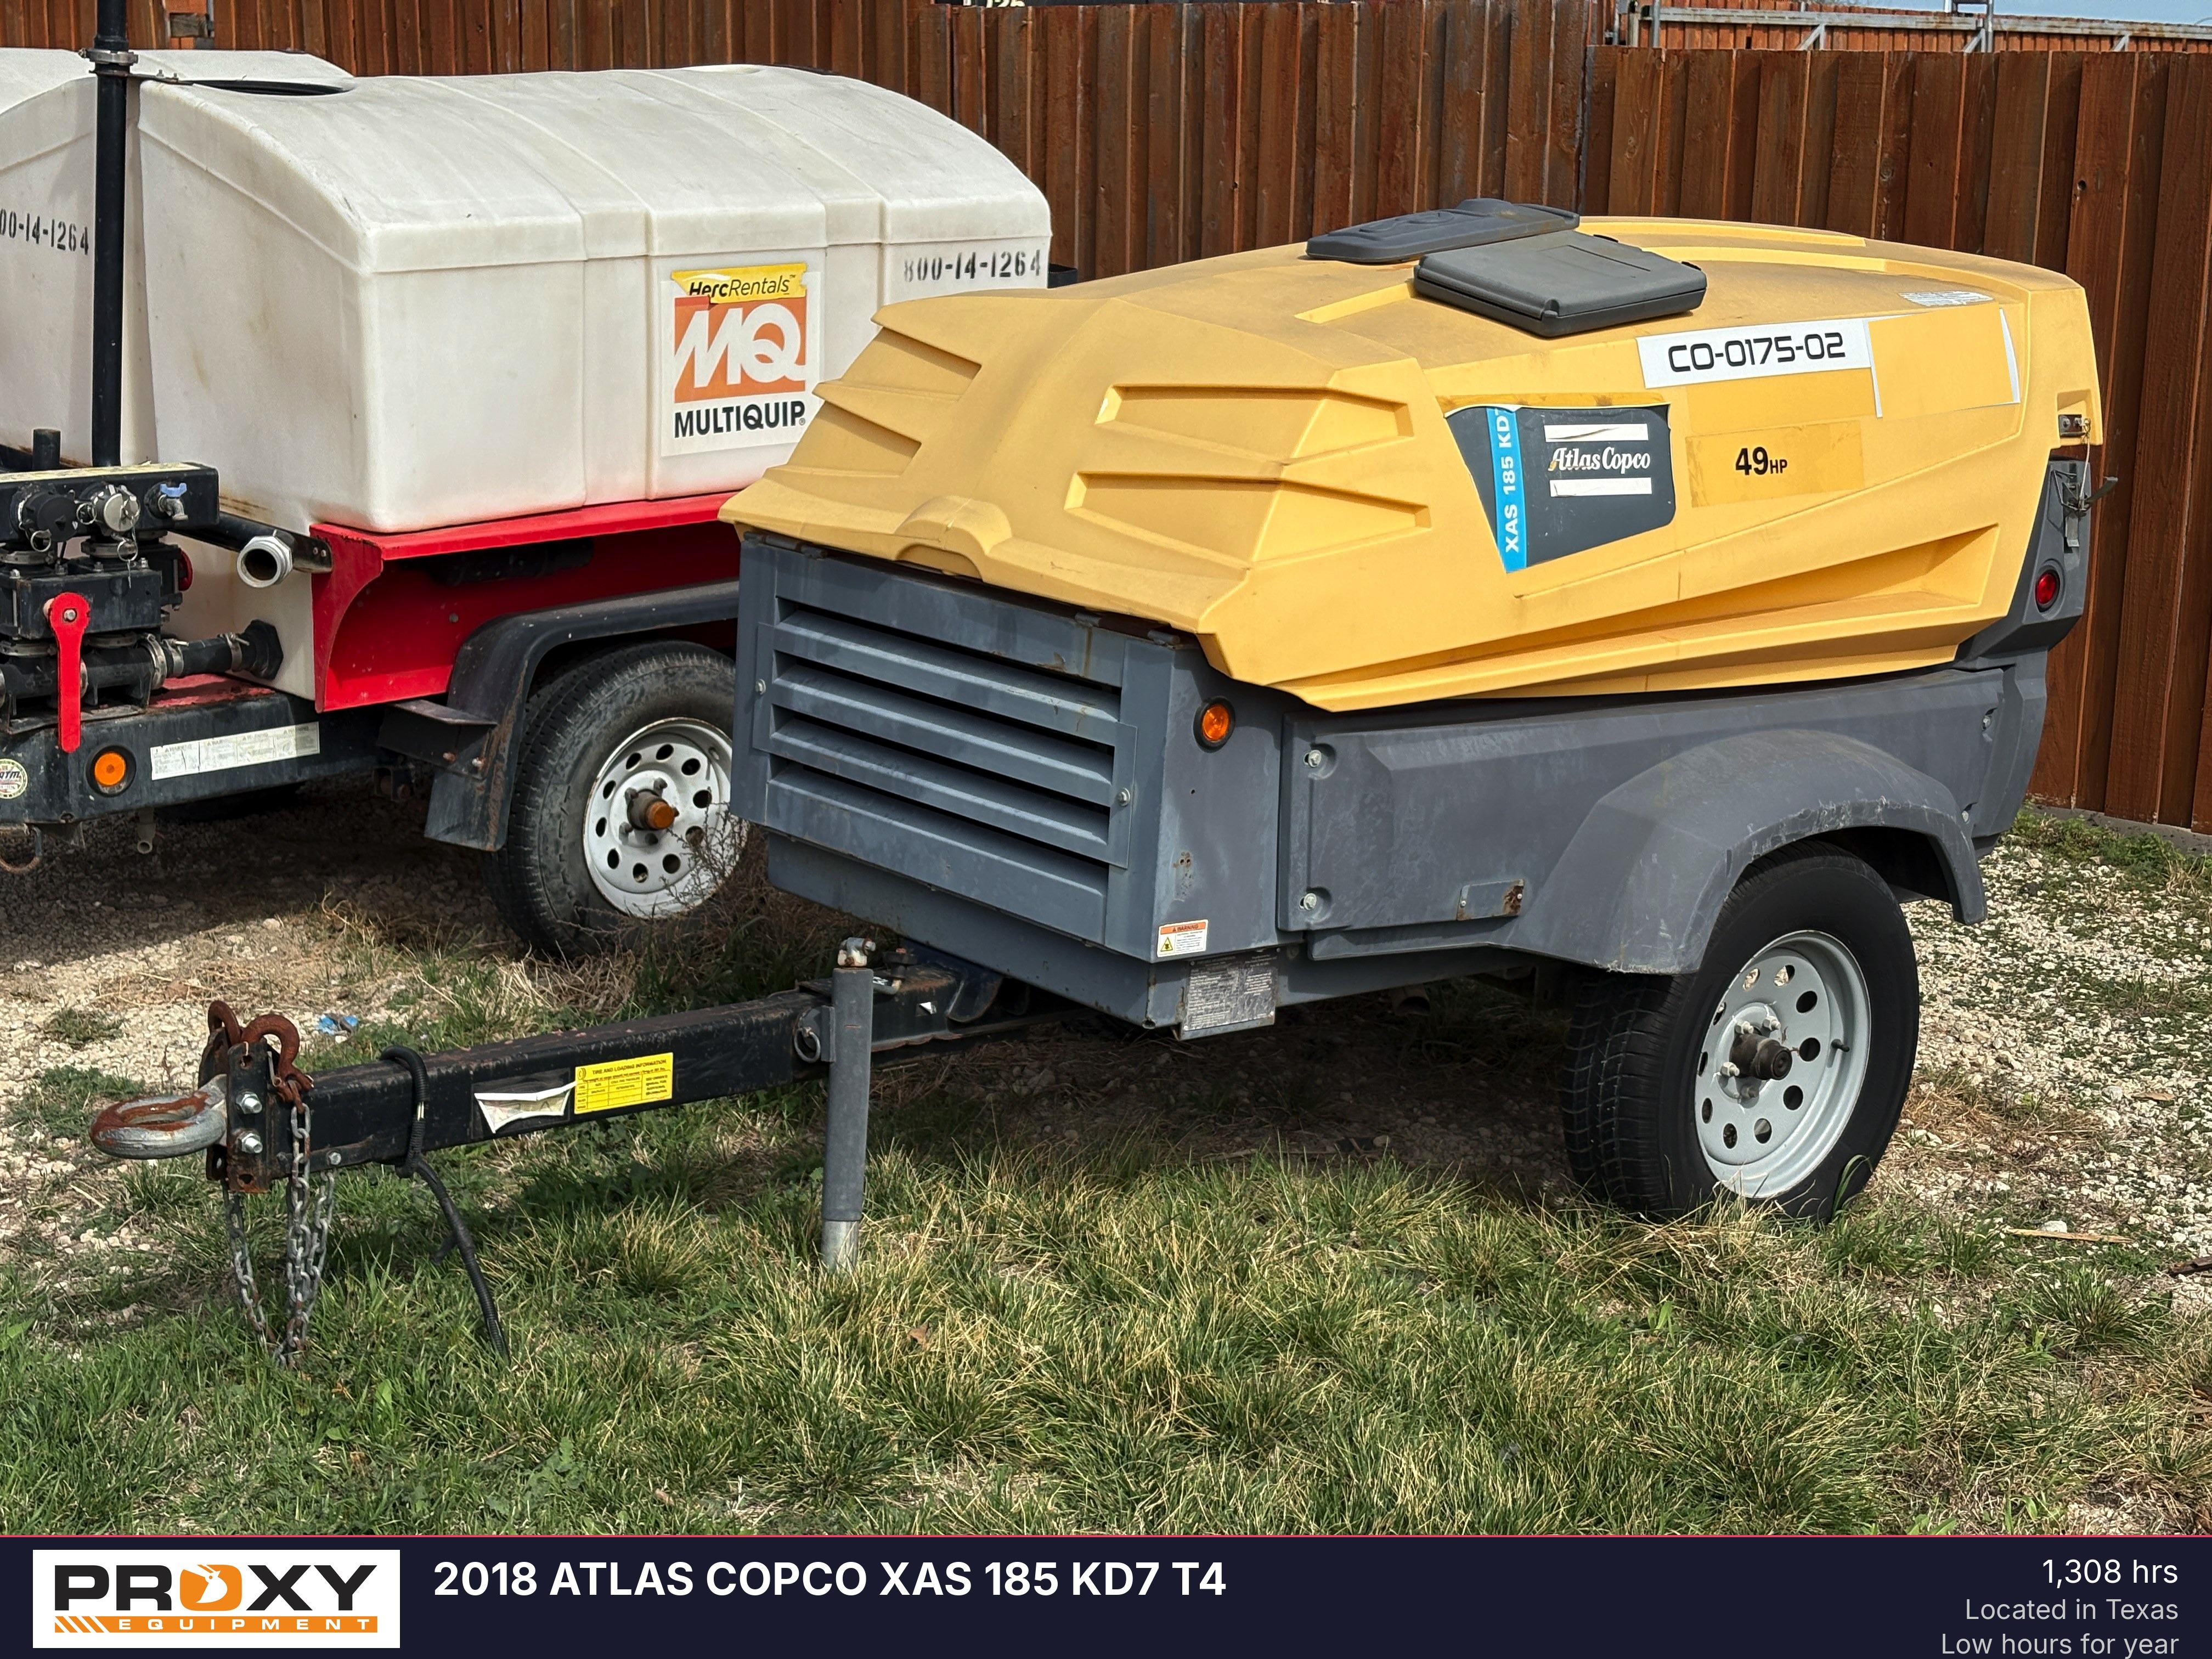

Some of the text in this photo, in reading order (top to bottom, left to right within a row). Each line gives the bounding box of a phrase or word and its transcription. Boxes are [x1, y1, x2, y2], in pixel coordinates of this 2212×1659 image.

[904, 249, 1041, 283] 800-14-1264
[674, 303, 806, 387] MQ
[1668, 332, 1846, 373] CO-0175-02
[1501, 456, 1516, 494] 185
[1602, 446, 1651, 474] Copco
[1504, 504, 1519, 553] XAS
